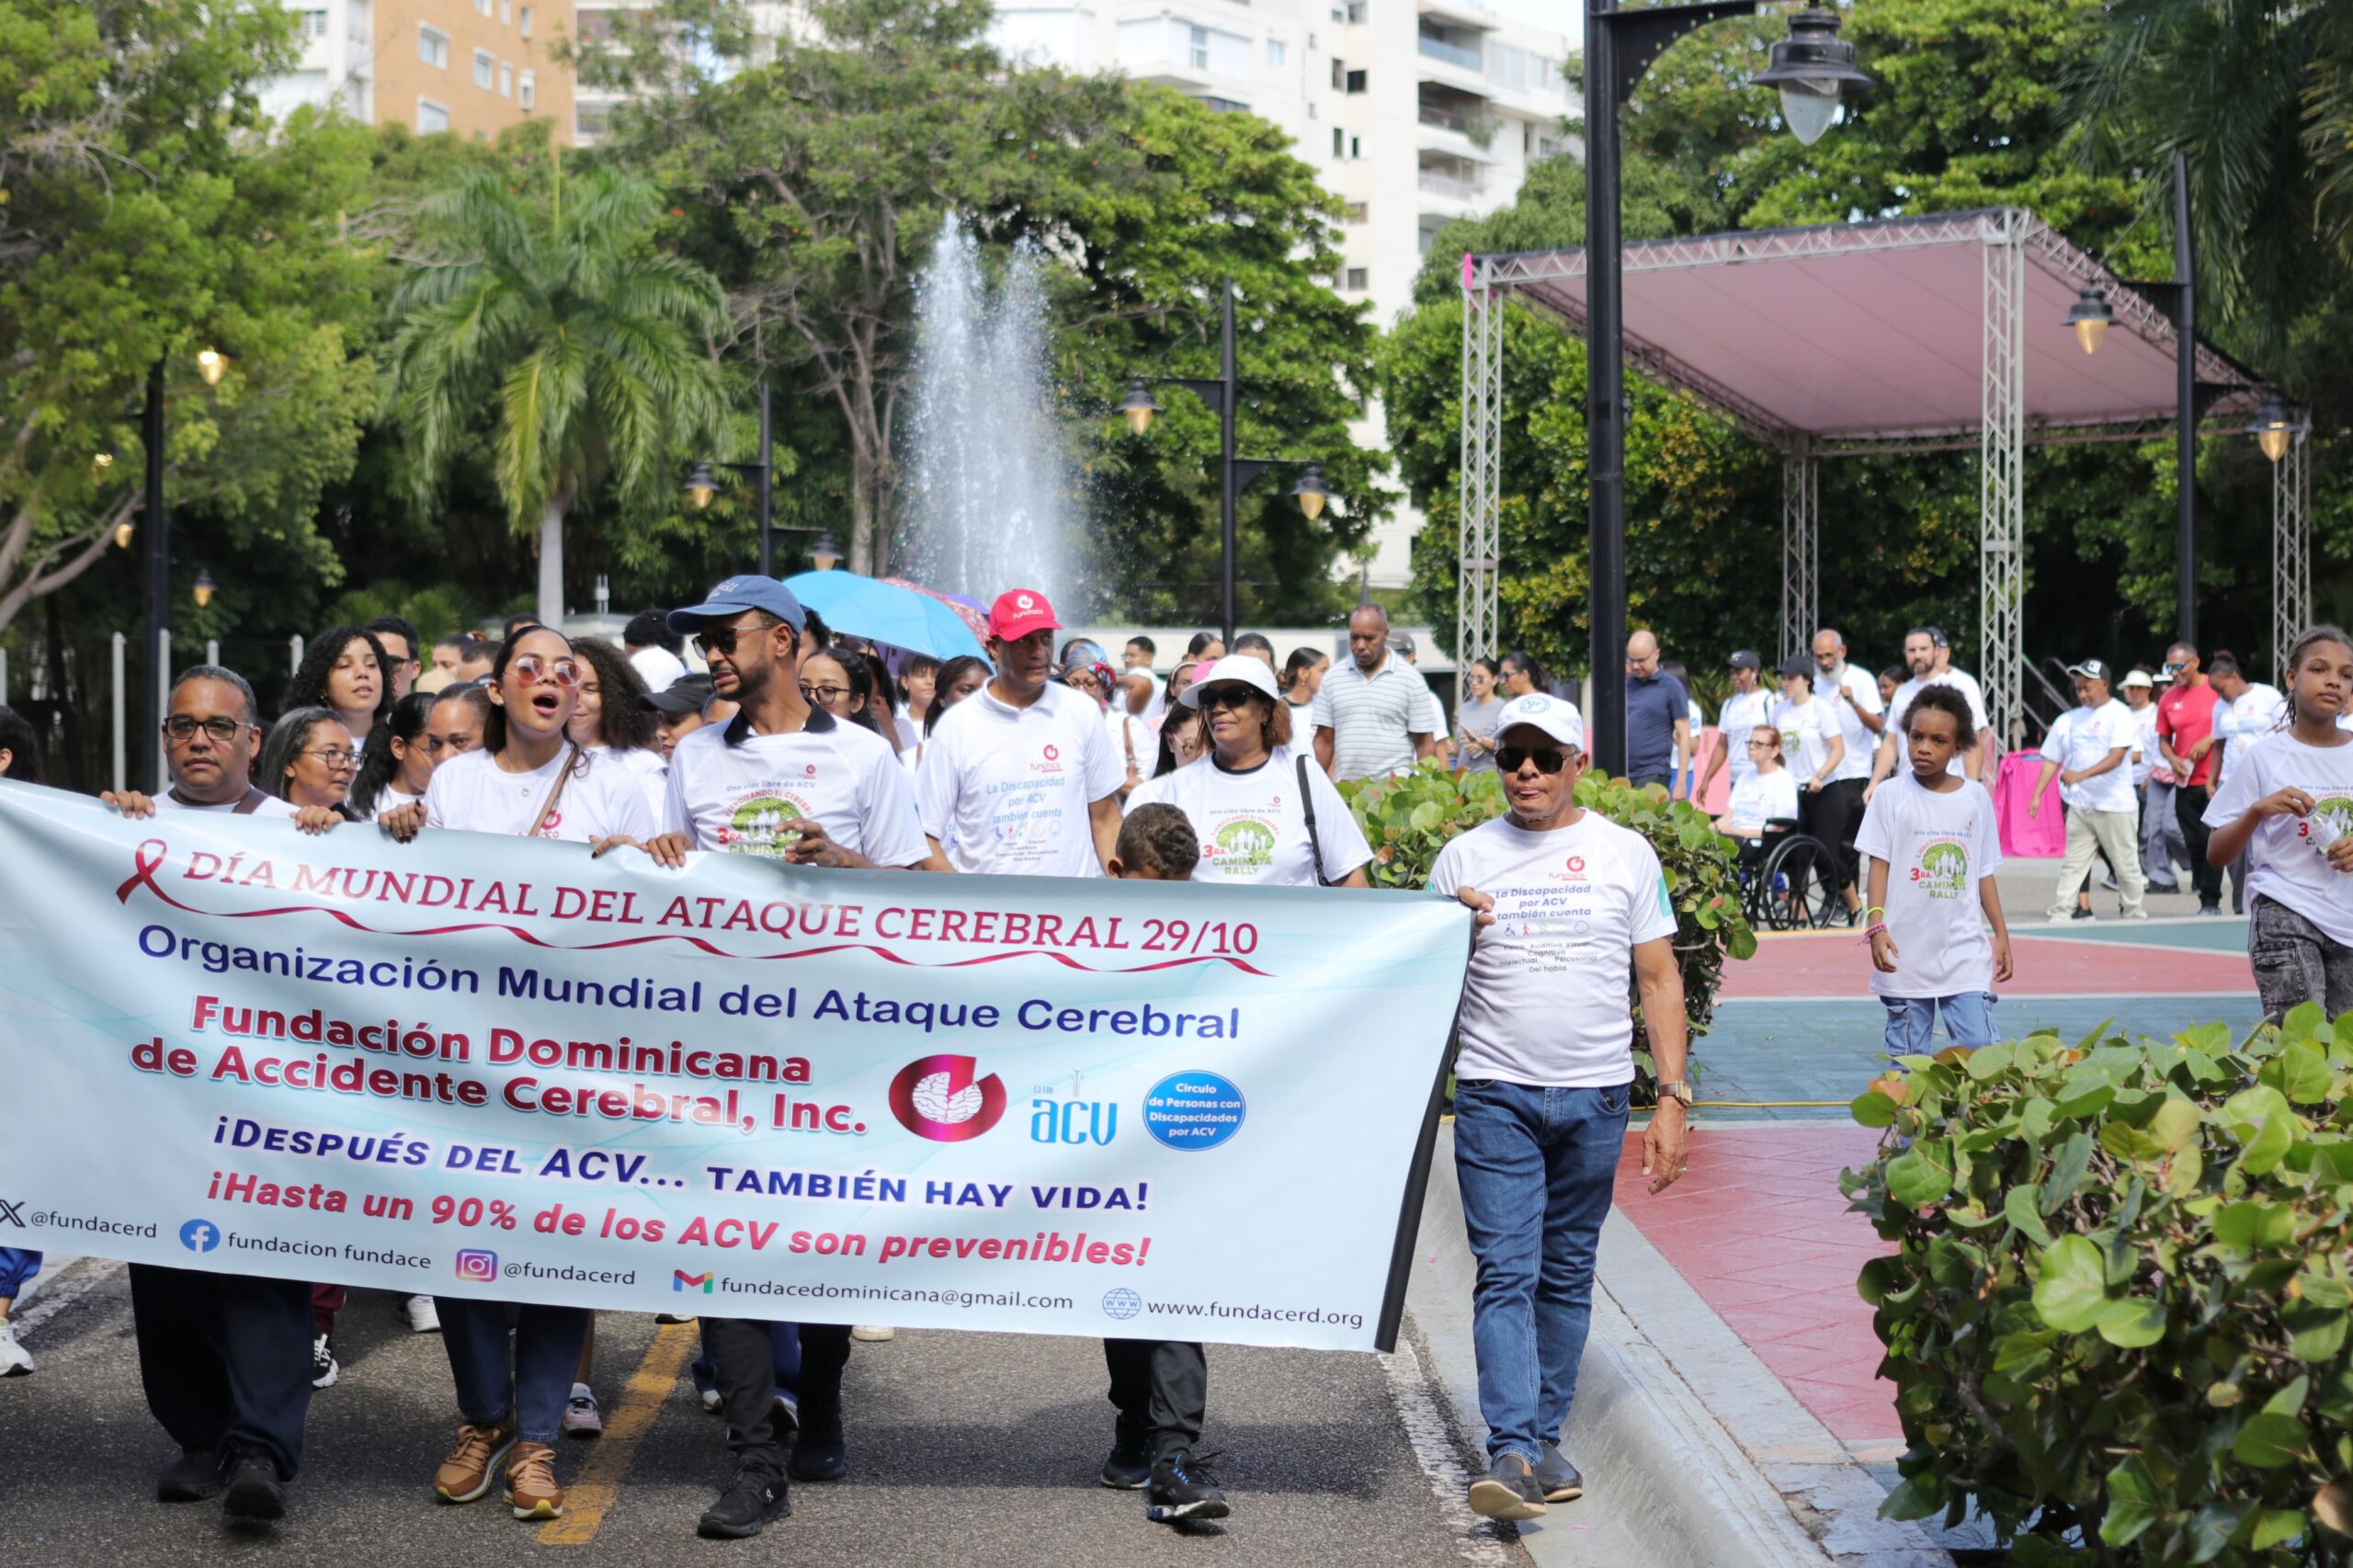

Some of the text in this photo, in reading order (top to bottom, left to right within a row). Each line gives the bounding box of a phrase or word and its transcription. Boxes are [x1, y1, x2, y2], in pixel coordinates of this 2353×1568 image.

[761, 779, 781, 788] libre
[986, 777, 1065, 795] La Discapacidad
[1007, 792, 1046, 808] por ACV
[1031, 809, 1063, 819] cuenta
[1224, 867, 1259, 875] RALLY
[1495, 884, 1591, 899] La Discapacidad
[1929, 891, 1960, 899] RALLY
[183, 851, 1258, 955] DÍA MUNDIAL DEL ATAQUE CEREBRAL 29/10
[1541, 897, 1568, 906] ACV
[1550, 907, 1592, 917] cuenta
[1543, 964, 1567, 972] habla
[138, 925, 1240, 1039] Organización Mundial del Ataque Cerebral
[191, 994, 813, 1085] Fundación Dominicana
[131, 1037, 869, 1134] de Accidente Cerebral, Inc.
[1149, 1097, 1241, 1108] de Personas con
[1149, 1111, 1238, 1123] Discapacidades
[1168, 1127, 1217, 1138] por ACV
[213, 1115, 1148, 1210] ¡DESPUÉS DEL ACV... TAMBIÉN HAY VIDA!
[30, 1211, 157, 1238] @fundacerd
[207, 1171, 1152, 1267] ¡Hasta un 90% de los ACV son prevenibles!
[228, 1233, 432, 1268] fundacion fundace
[504, 1262, 636, 1285] @fundacerd
[722, 1277, 1074, 1310] fundacedominicana@gmail.com
[1147, 1301, 1363, 1329] www.fundacerd.org
